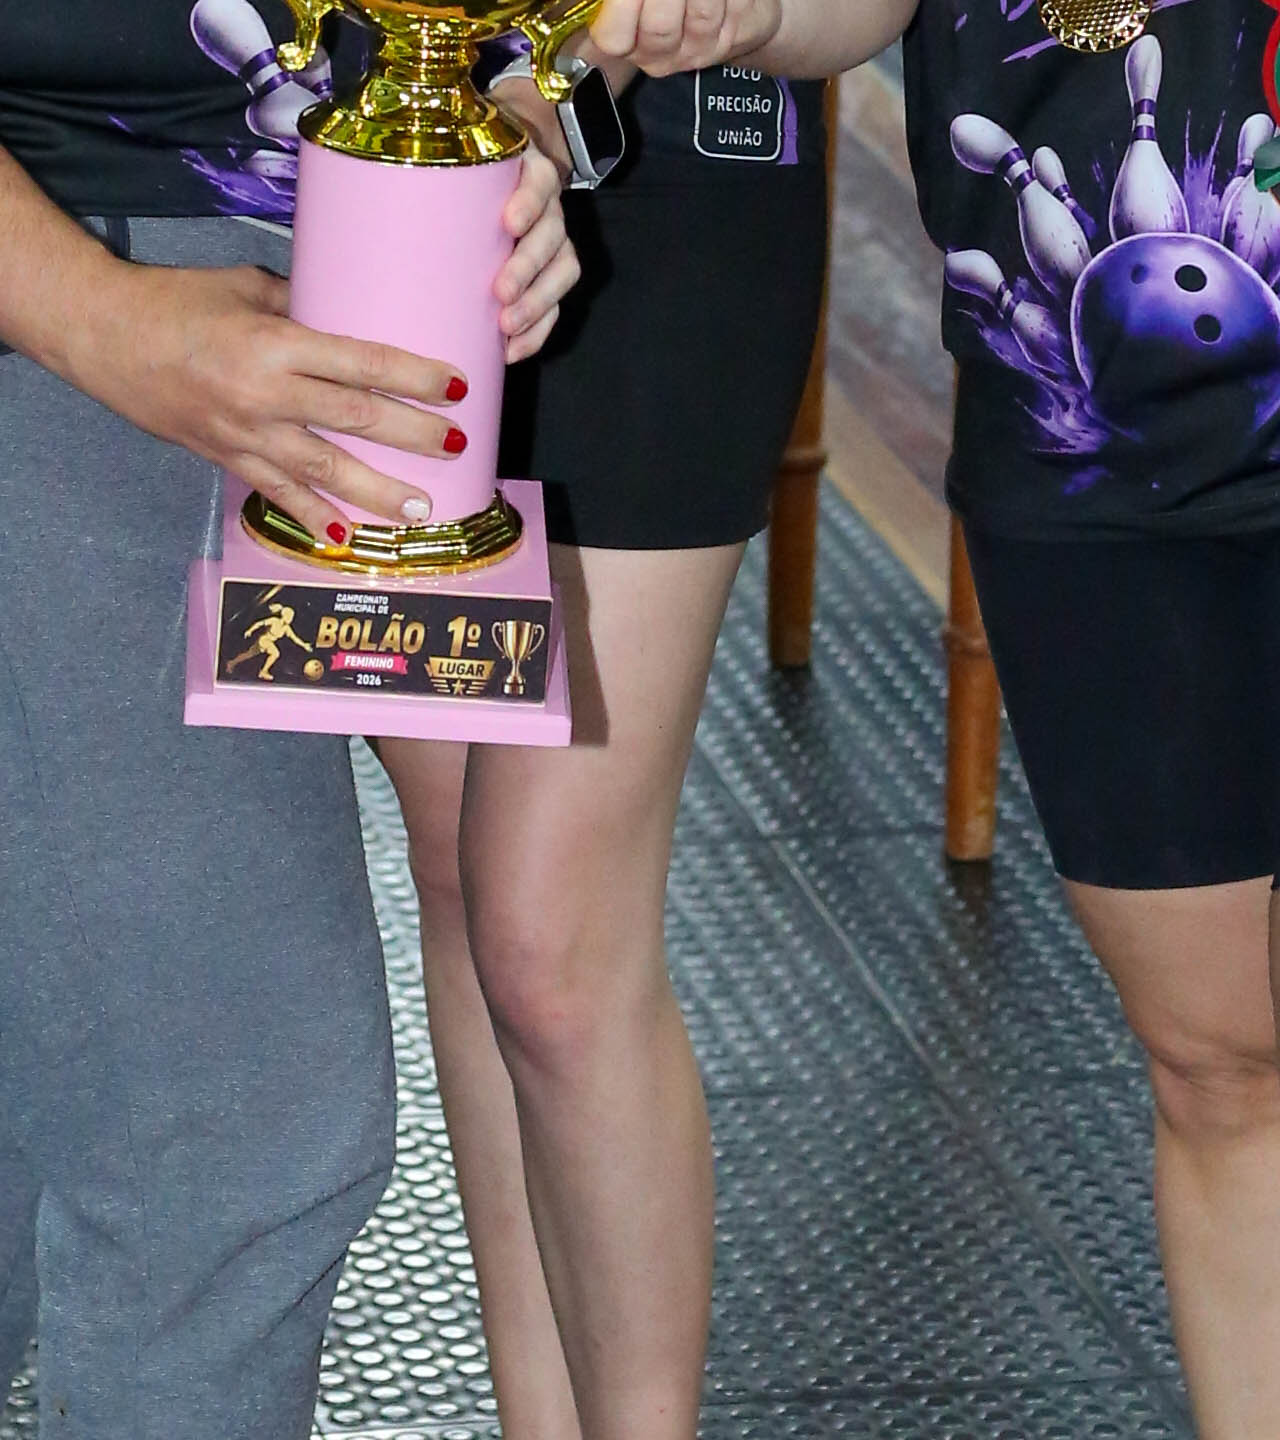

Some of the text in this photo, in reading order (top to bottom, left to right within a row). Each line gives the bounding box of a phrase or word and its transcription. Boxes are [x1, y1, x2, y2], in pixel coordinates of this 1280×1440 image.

[707, 94, 772, 114] PRECISÃO
[717, 127, 763, 147] UNIÃO
[334, 602, 389, 615] MUNICIPAL DE
[336, 593, 389, 605] CAMPEONATO
[315, 613, 482, 657] BOLÃO 1º
[344, 654, 486, 677] FEMININO LUGAR
[356, 674, 382, 686] 2026
